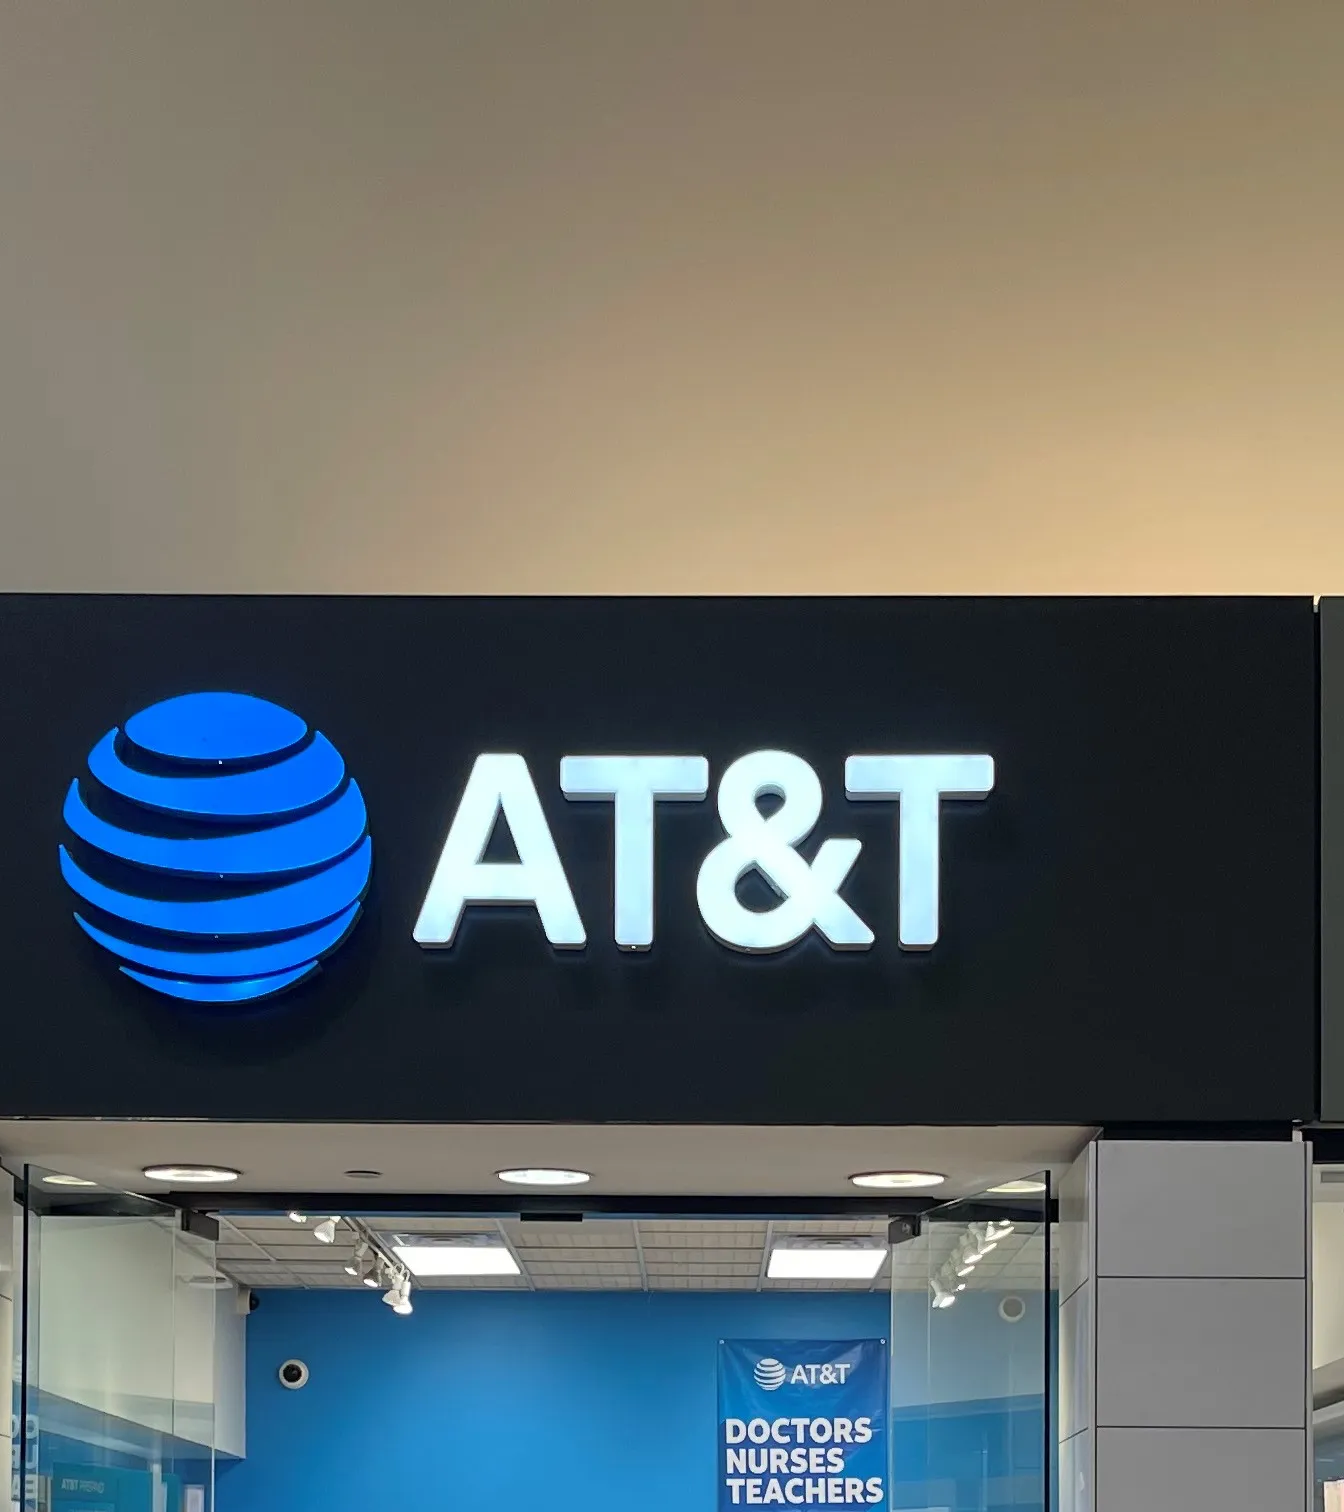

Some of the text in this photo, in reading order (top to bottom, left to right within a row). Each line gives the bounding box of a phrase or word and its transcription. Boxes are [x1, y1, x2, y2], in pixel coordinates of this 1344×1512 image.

[413, 749, 995, 952] AT&T
[790, 1363, 851, 1386] AT&T
[724, 1417, 874, 1445] DOCTORS
[725, 1448, 845, 1475] NURSES
[726, 1477, 884, 1505] TEACHERS
